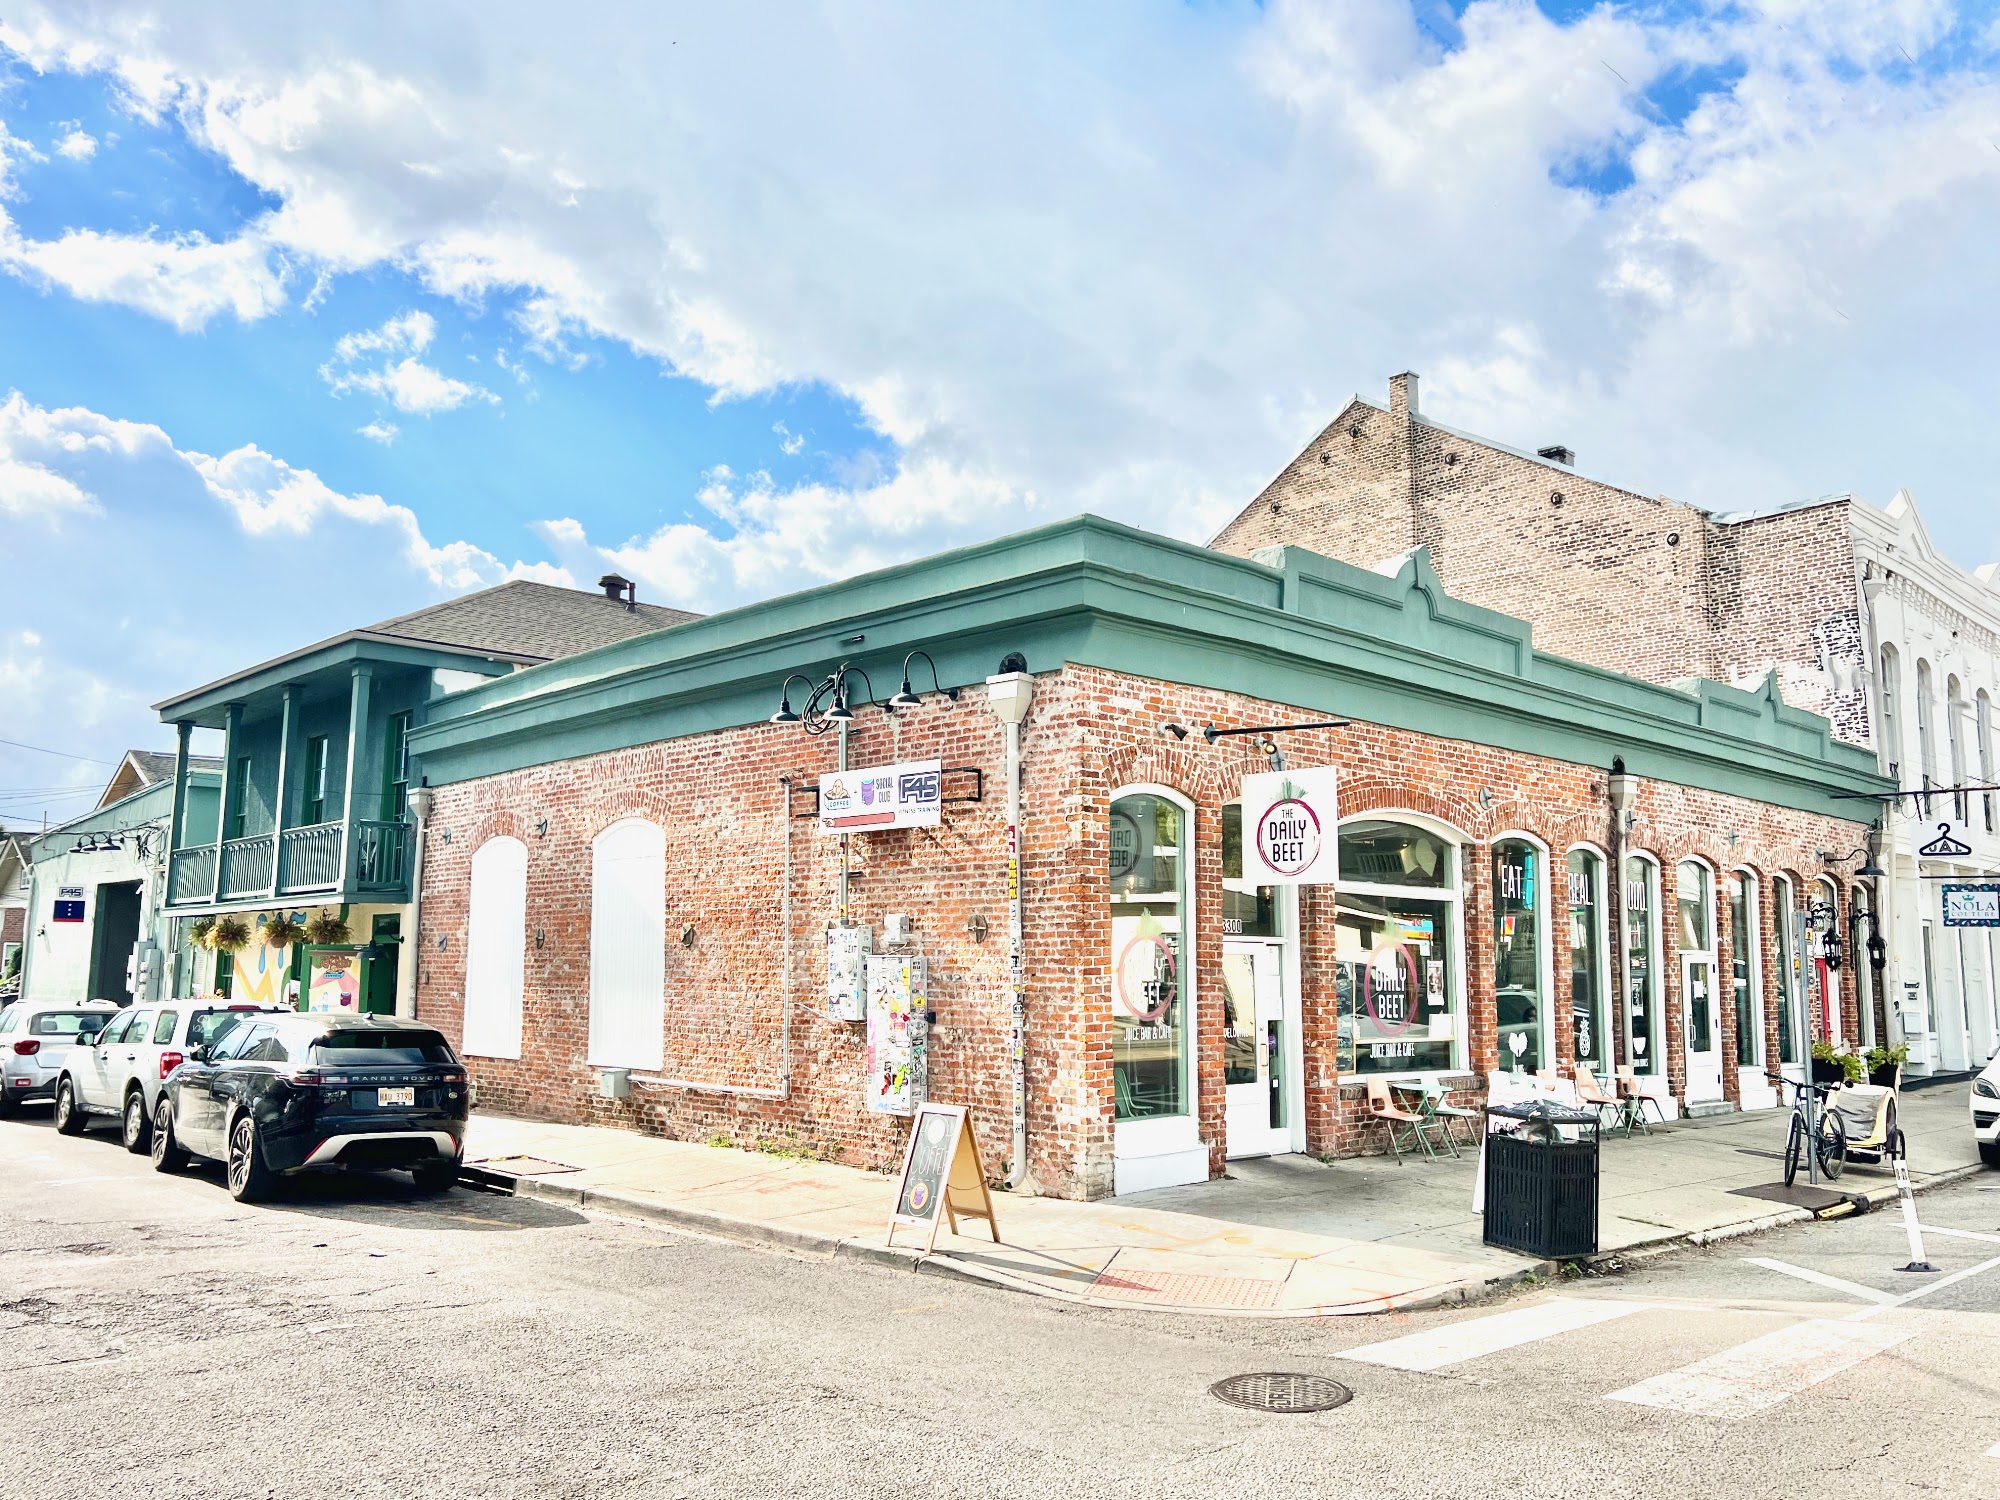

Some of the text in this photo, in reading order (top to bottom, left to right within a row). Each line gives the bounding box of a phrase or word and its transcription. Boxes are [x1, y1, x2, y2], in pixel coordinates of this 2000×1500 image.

[876, 777, 893, 789] SOCIAL
[900, 773, 939, 801] F45
[829, 799, 849, 808] COFFEE
[879, 791, 891, 803] CLUB
[1282, 809, 1293, 818] THE
[1269, 820, 1306, 840] DAILY
[1272, 842, 1304, 862] BEET
[1928, 840, 1962, 852] JAL
[1501, 865, 1526, 899] EAT.
[59, 887, 83, 898] F45
[1627, 881, 1648, 911] OOD.
[1951, 901, 1996, 911] NOLA
[1375, 967, 1407, 992] DAILY
[1378, 994, 1405, 1019] BEET
[1124, 1025, 1172, 1041] JUICE BAR & CAFE
[1370, 1042, 1415, 1058] JUICE BAR & CAFE
[911, 1142, 949, 1176] COFFEE
